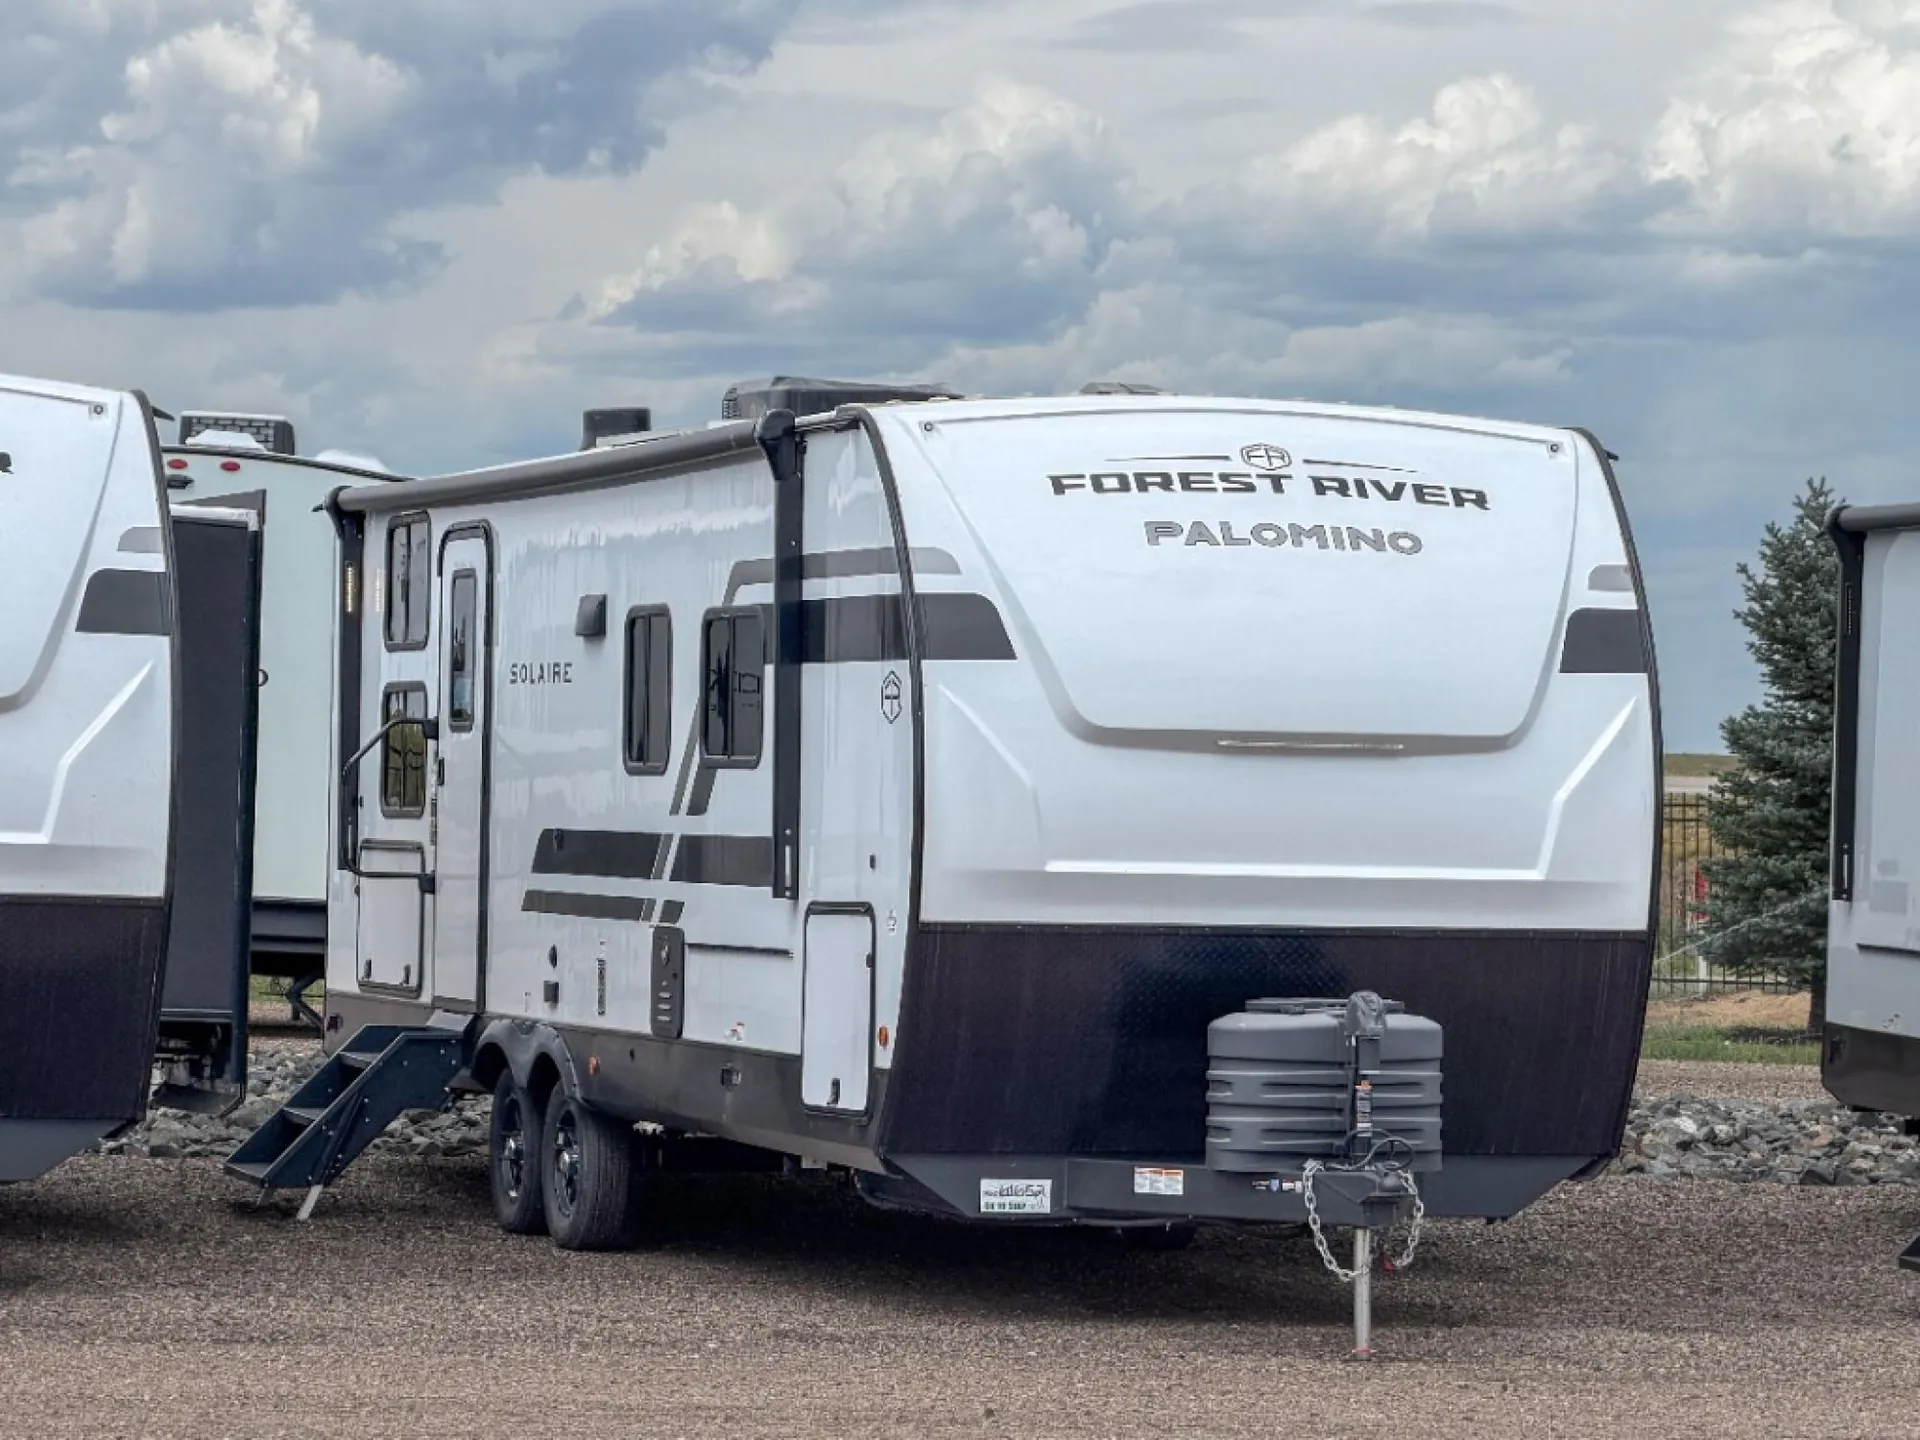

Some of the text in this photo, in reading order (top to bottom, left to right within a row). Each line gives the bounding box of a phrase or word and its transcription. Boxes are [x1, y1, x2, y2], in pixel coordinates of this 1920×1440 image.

[1048, 472, 1490, 510] FOREST RIVER
[1144, 521, 1423, 555] PALOMINO
[509, 662, 572, 684] SOLAIRE
